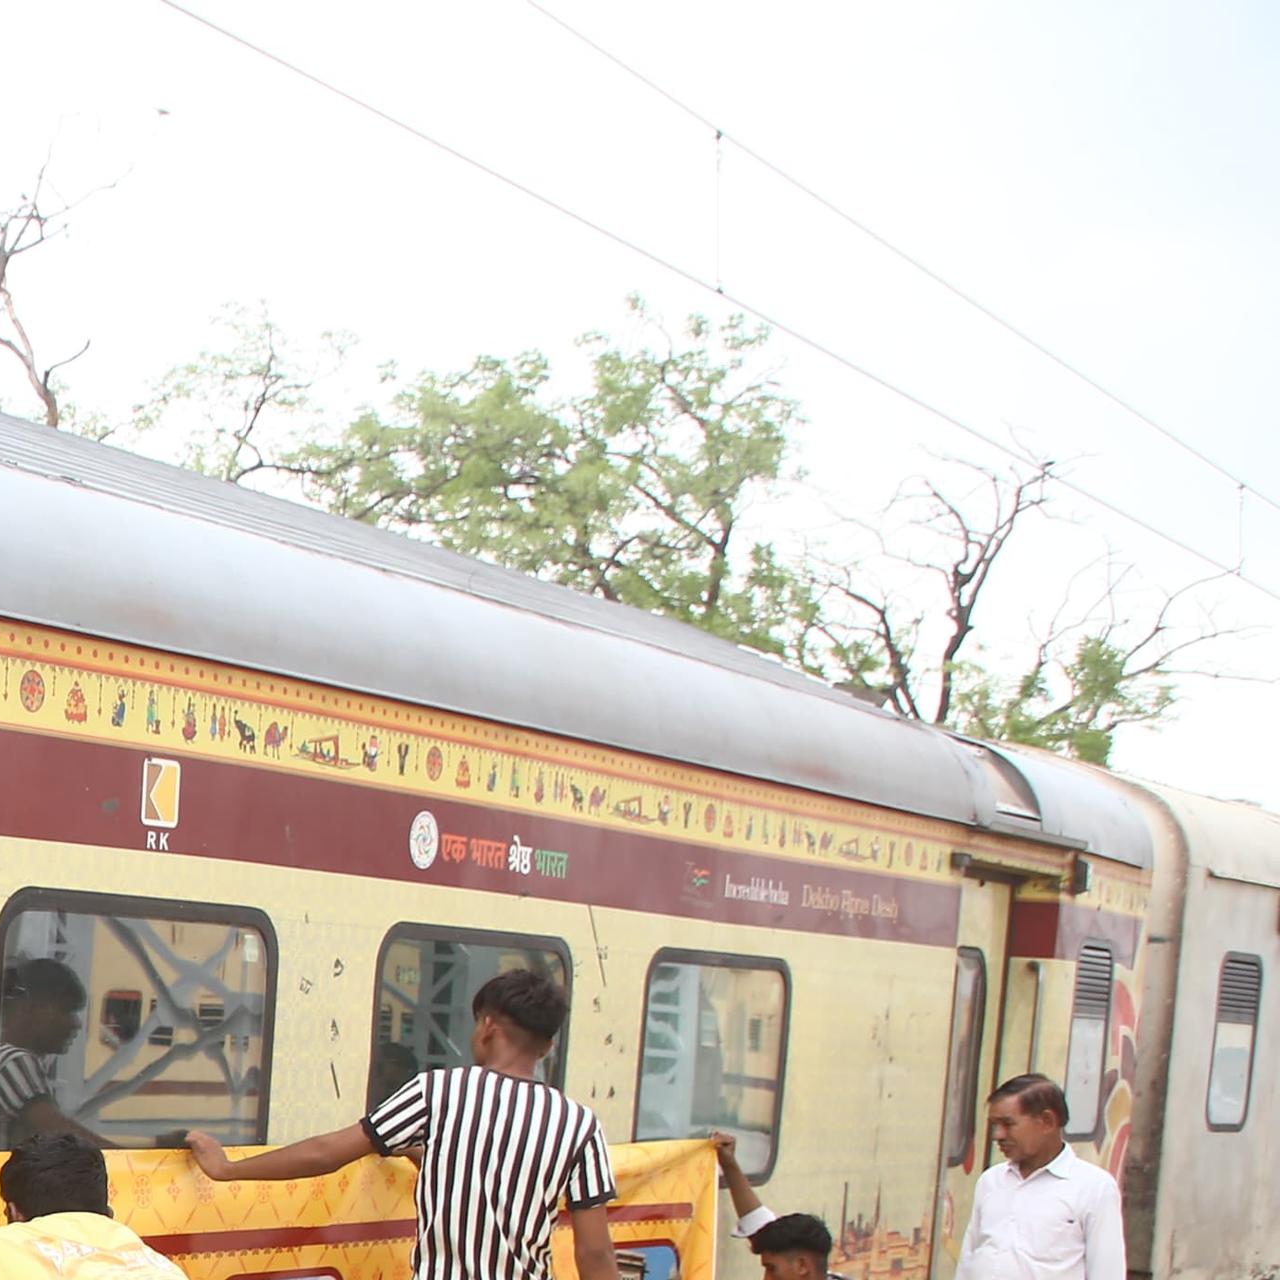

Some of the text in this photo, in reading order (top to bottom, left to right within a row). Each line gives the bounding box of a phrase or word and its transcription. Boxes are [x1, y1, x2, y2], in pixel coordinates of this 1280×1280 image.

[146, 830, 170, 851] RK
[441, 833, 468, 864] एक
[470, 838, 508, 869] भारत
[535, 849, 569, 879] भारत
